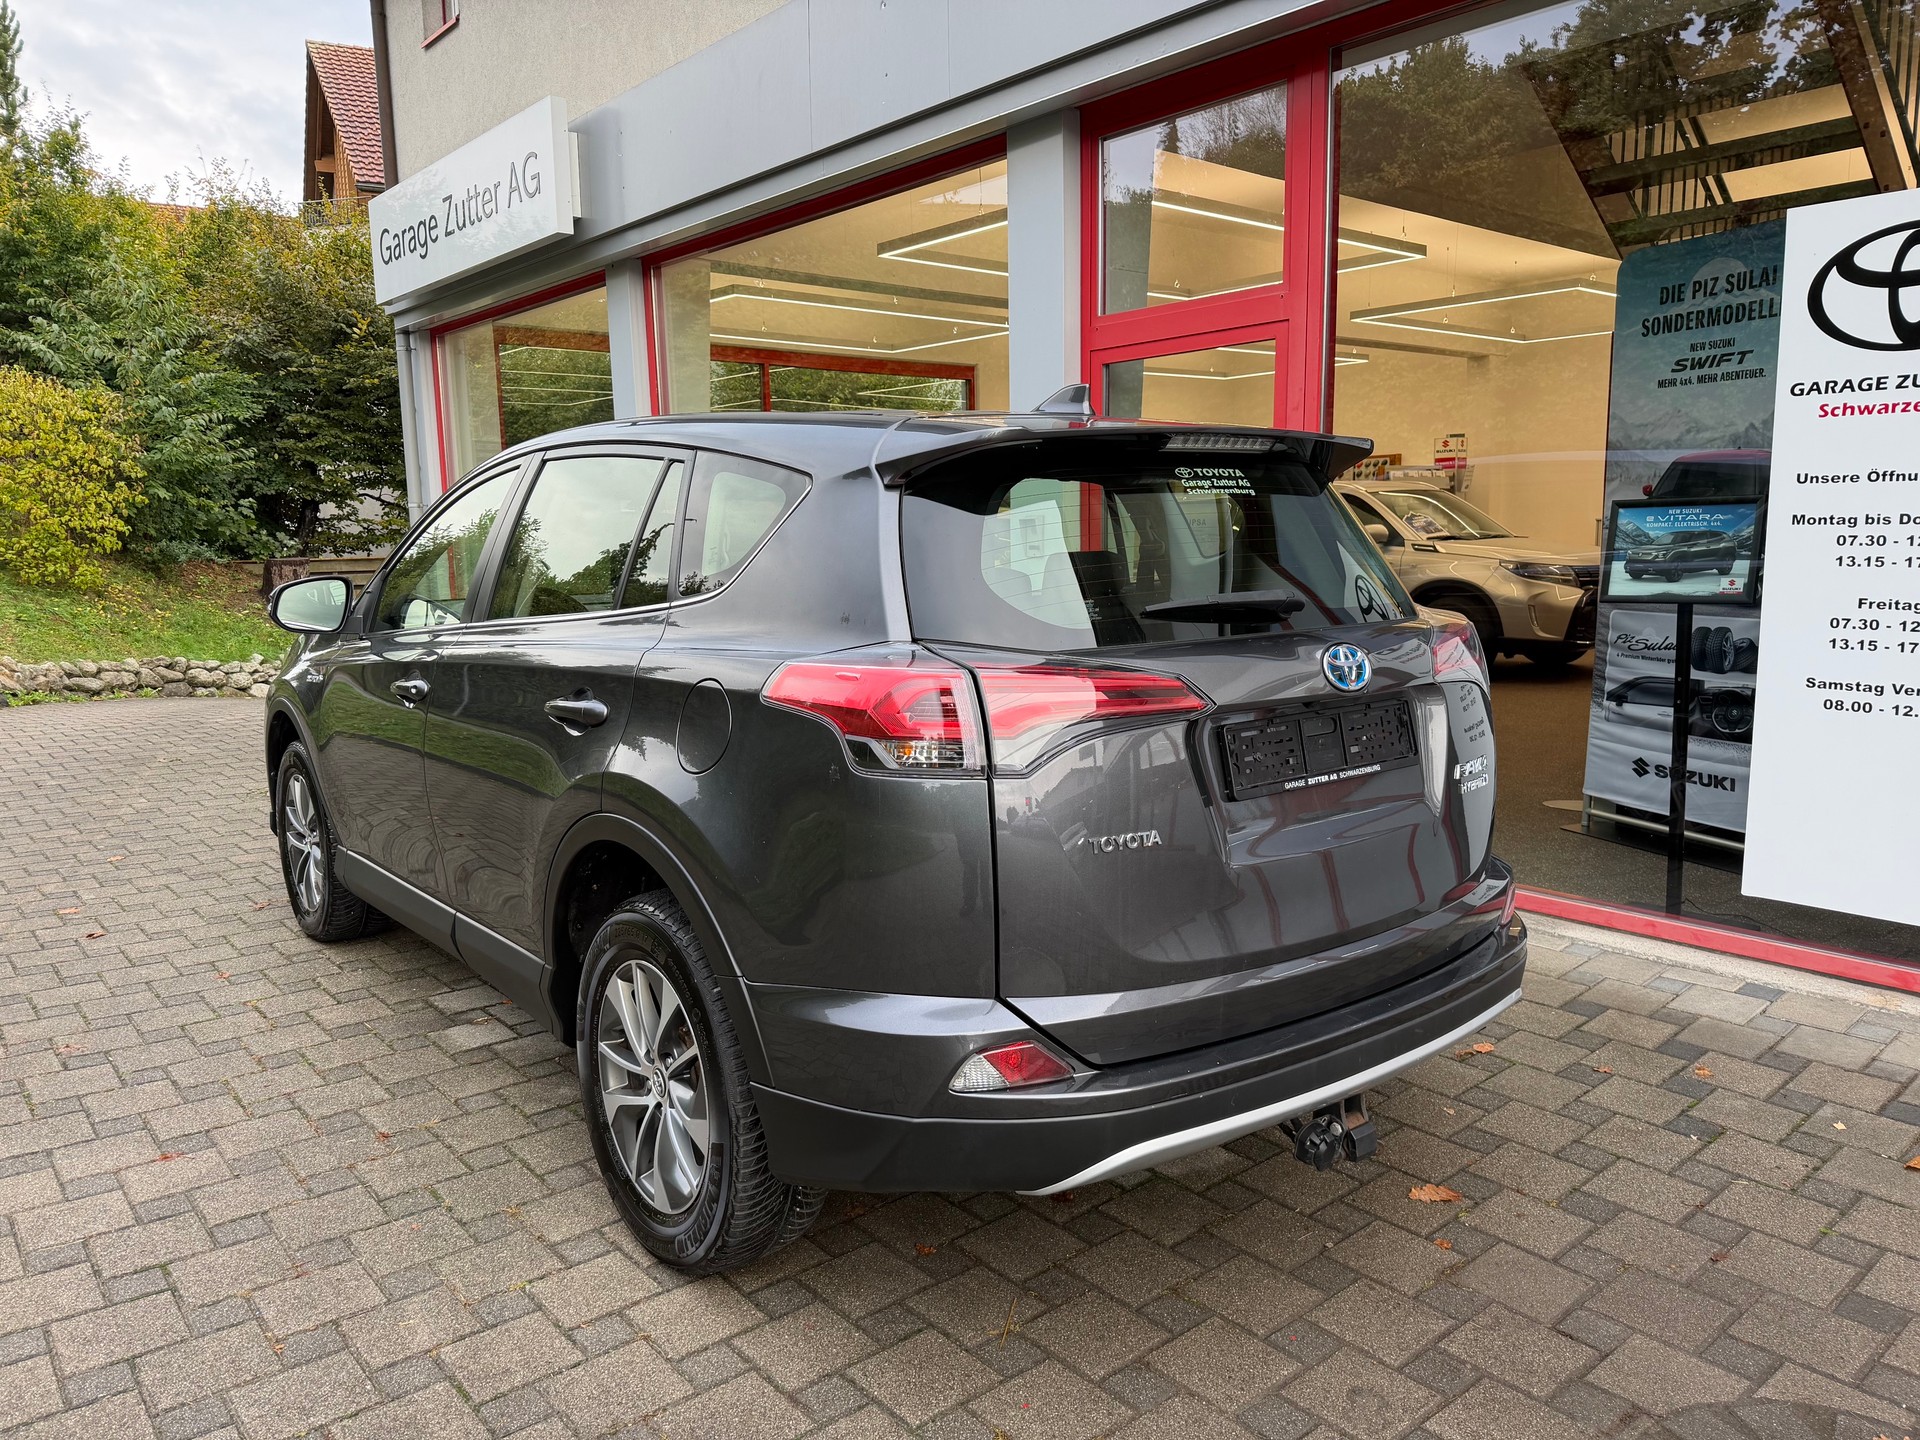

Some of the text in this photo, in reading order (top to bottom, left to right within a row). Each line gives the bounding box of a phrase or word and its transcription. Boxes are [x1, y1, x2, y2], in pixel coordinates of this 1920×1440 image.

[379, 151, 541, 266] Garage Zutter AG
[1659, 282, 1686, 306] DIE
[1691, 276, 1720, 300] PIZ
[1641, 297, 1781, 338] SONDERMODELL
[1690, 337, 1736, 353] NEW SUZUKI
[1670, 349, 1755, 373] SWIFT
[1657, 367, 1767, 389] MEHR 4x4. MEHR ABENTEUER.
[1789, 375, 1890, 397] GARAGE
[1193, 468, 1245, 477] TOYOTA
[1796, 472, 1860, 484] Unsere
[1181, 478, 1251, 488] Garage Zutter AG
[1186, 487, 1256, 496] Schwarzenburg
[1657, 513, 1724, 522] VITARA
[1791, 514, 1858, 529] Montag
[1864, 513, 1892, 525] bis
[1836, 534, 1887, 547] 07.30
[1835, 555, 1885, 568] 13.15
[1829, 617, 1880, 631] 07.30
[1613, 633, 1636, 645] Piz
[1828, 637, 1878, 652] 13.15
[1897, 641, 1920, 654] 17
[1805, 677, 1885, 697] Samstag
[1823, 698, 1873, 714] 08.00
[1284, 779, 1306, 790] GARAGE
[1307, 775, 1329, 785] ZUTTER
[1339, 764, 1381, 779] SCHWARZENBURG
[1654, 764, 1736, 792] SZUKI
[1088, 829, 1163, 855] TOYOTA
